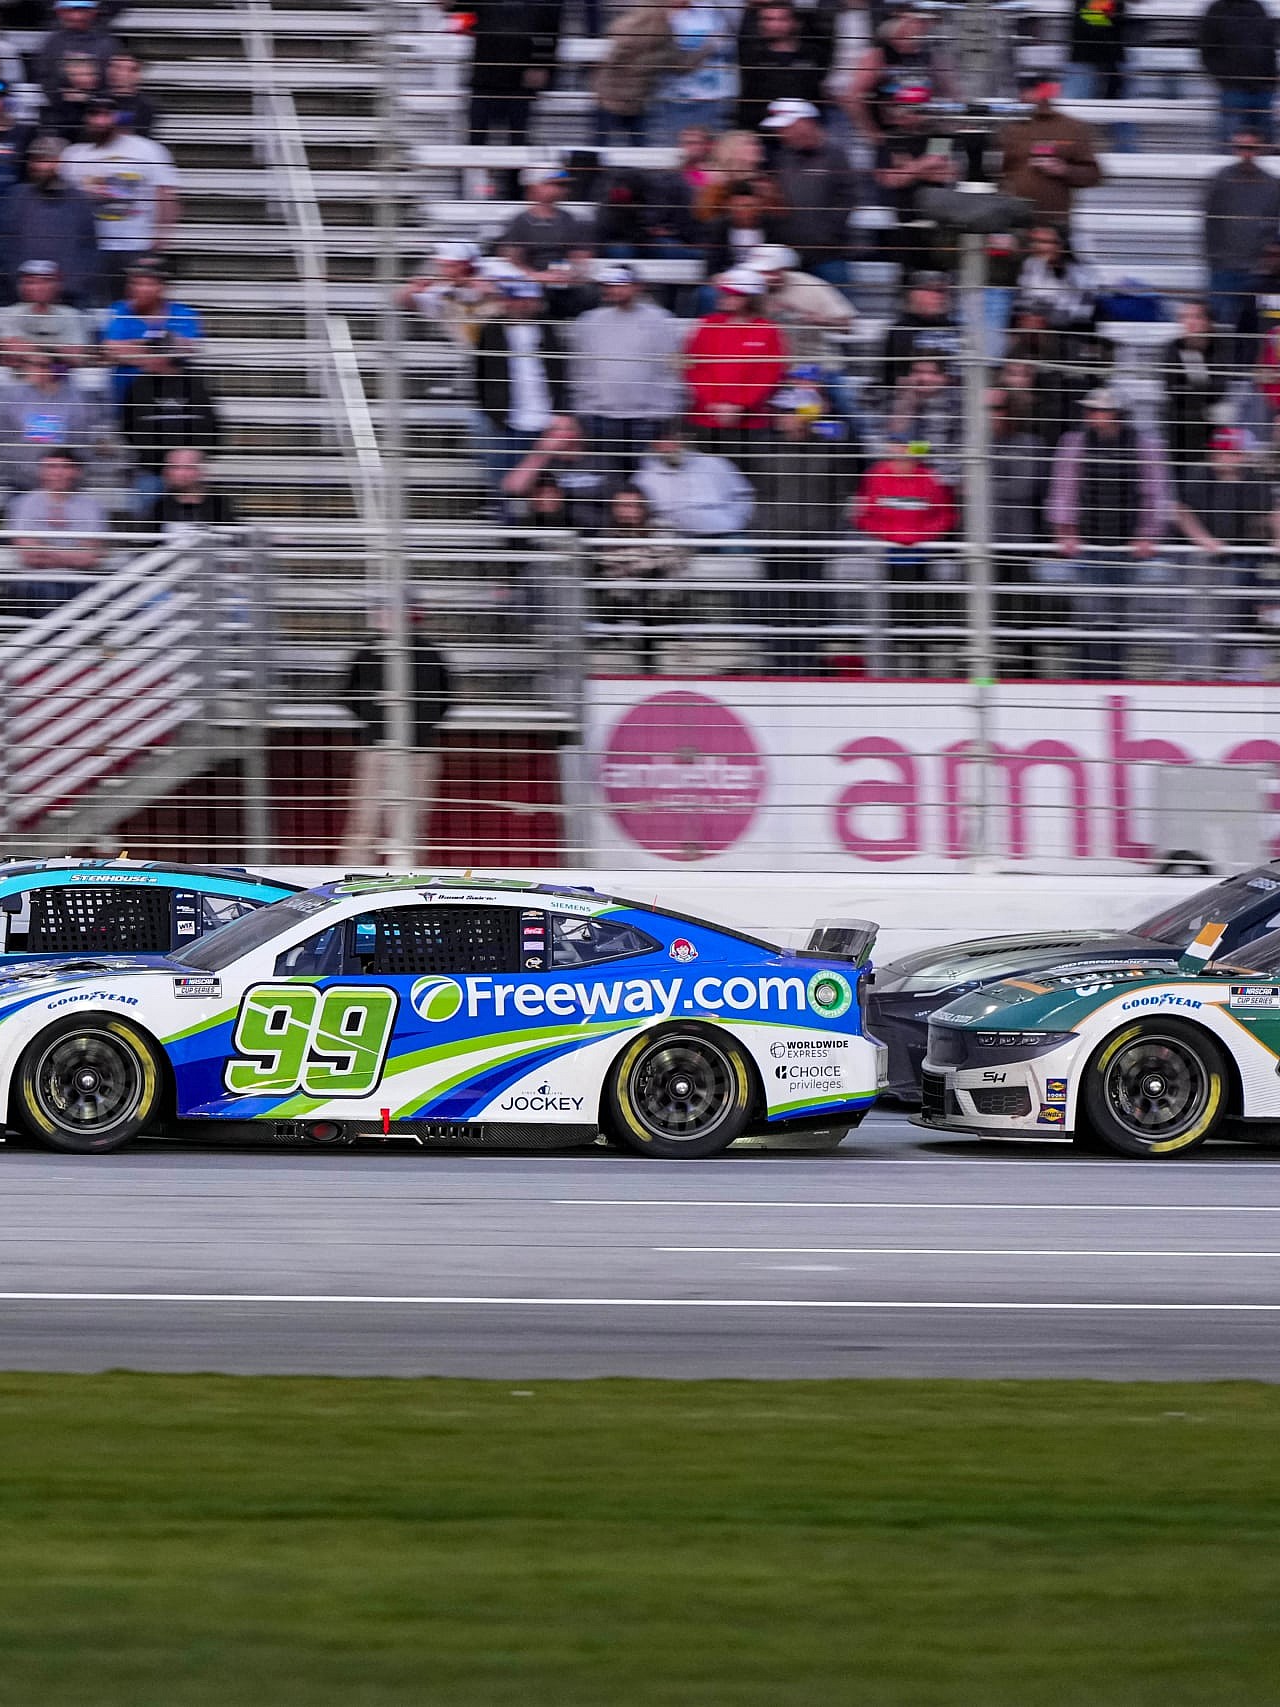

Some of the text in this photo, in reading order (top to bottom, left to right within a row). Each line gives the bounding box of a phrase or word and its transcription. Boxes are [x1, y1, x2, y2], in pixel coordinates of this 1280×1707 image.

[71, 874, 147, 882] STENHOUSE
[551, 901, 591, 912] SIEMENS
[181, 986, 215, 994] CUP SERIES
[1246, 987, 1273, 995] NASCAR
[47, 991, 139, 1010] GOODYEAR
[467, 976, 806, 1018] Freeway.com
[1122, 993, 1202, 1010] GOODYEAR
[1236, 996, 1273, 1005] CUP SERIES
[225, 984, 398, 1098] 99
[787, 1040, 849, 1049] WORLDWIDE
[787, 1050, 828, 1058] EXPRESS
[789, 1066, 841, 1077] CHOICE
[501, 1097, 584, 1110] JOCKEY
